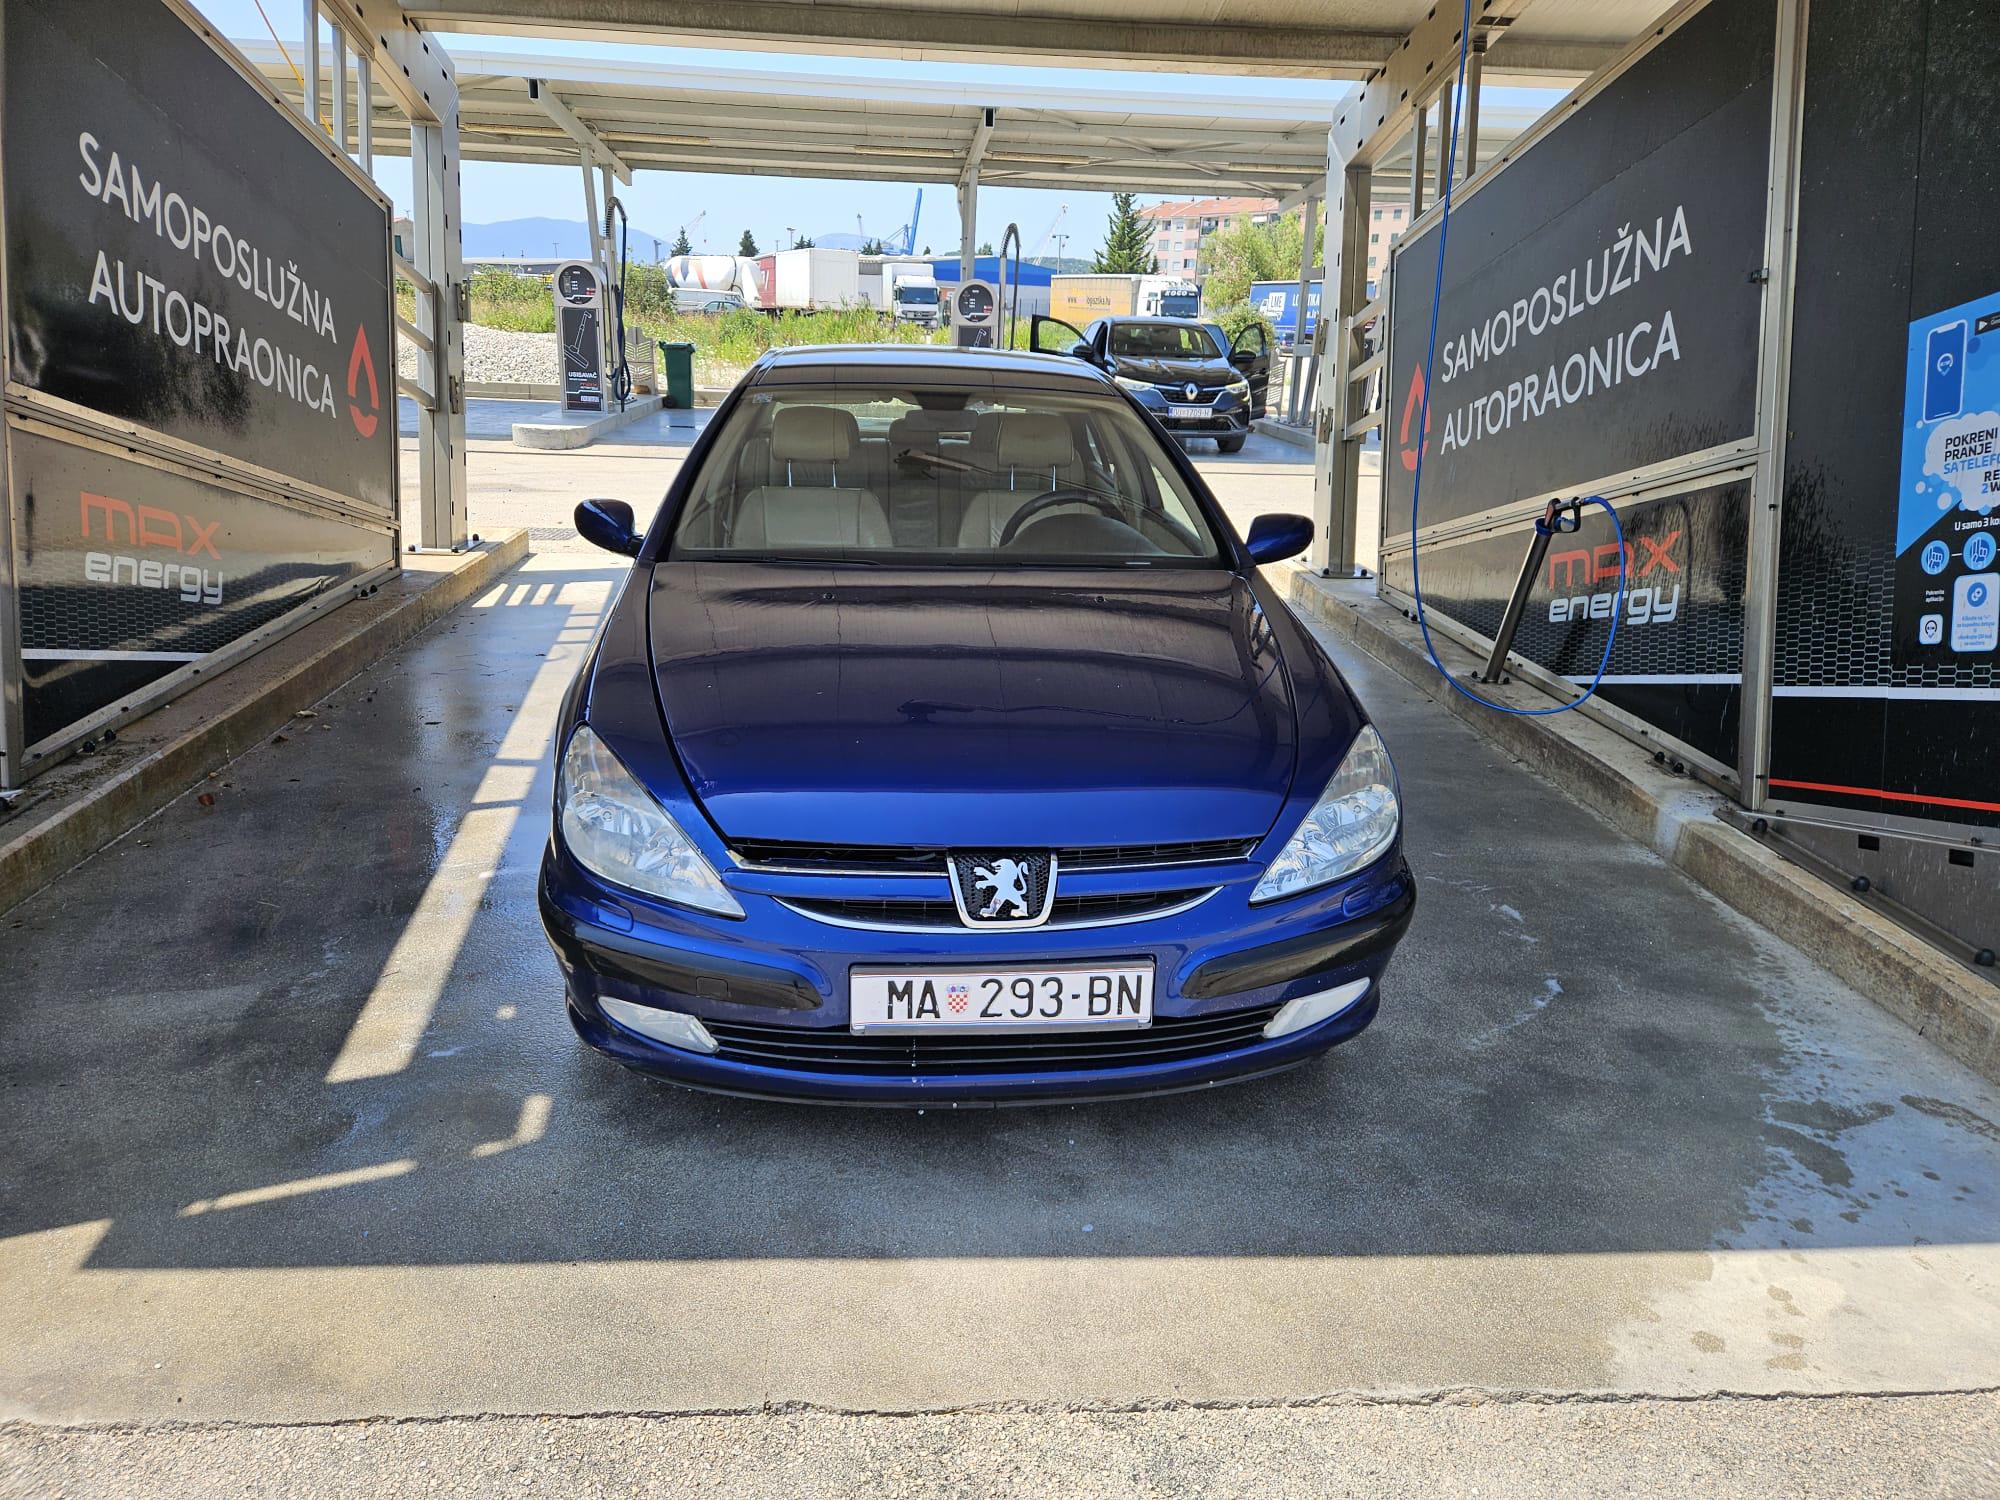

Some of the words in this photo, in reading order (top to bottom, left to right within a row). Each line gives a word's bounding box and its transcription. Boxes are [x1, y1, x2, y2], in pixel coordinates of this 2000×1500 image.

[78, 132, 337, 344] SAMOPOSLUŽNA
[1441, 205, 1692, 383] SAMOPOSLUŽNA
[88, 250, 337, 419] AUTOPRAONICA
[1440, 310, 1681, 455] AUTOPRAONICA
[1944, 441, 1992, 462] PRANJE
[1945, 427, 1998, 449] POKRENI
[1944, 461, 1959, 474] SA
[1981, 483, 1989, 494] 2
[1954, 521, 1961, 531] U
[1961, 519, 1982, 530] samo
[1983, 517, 1989, 527] 3
[85, 551, 223, 605] energy
[1548, 583, 1680, 625] energy
[887, 979, 941, 1020] MA
[979, 974, 1143, 1018] 293-BN
